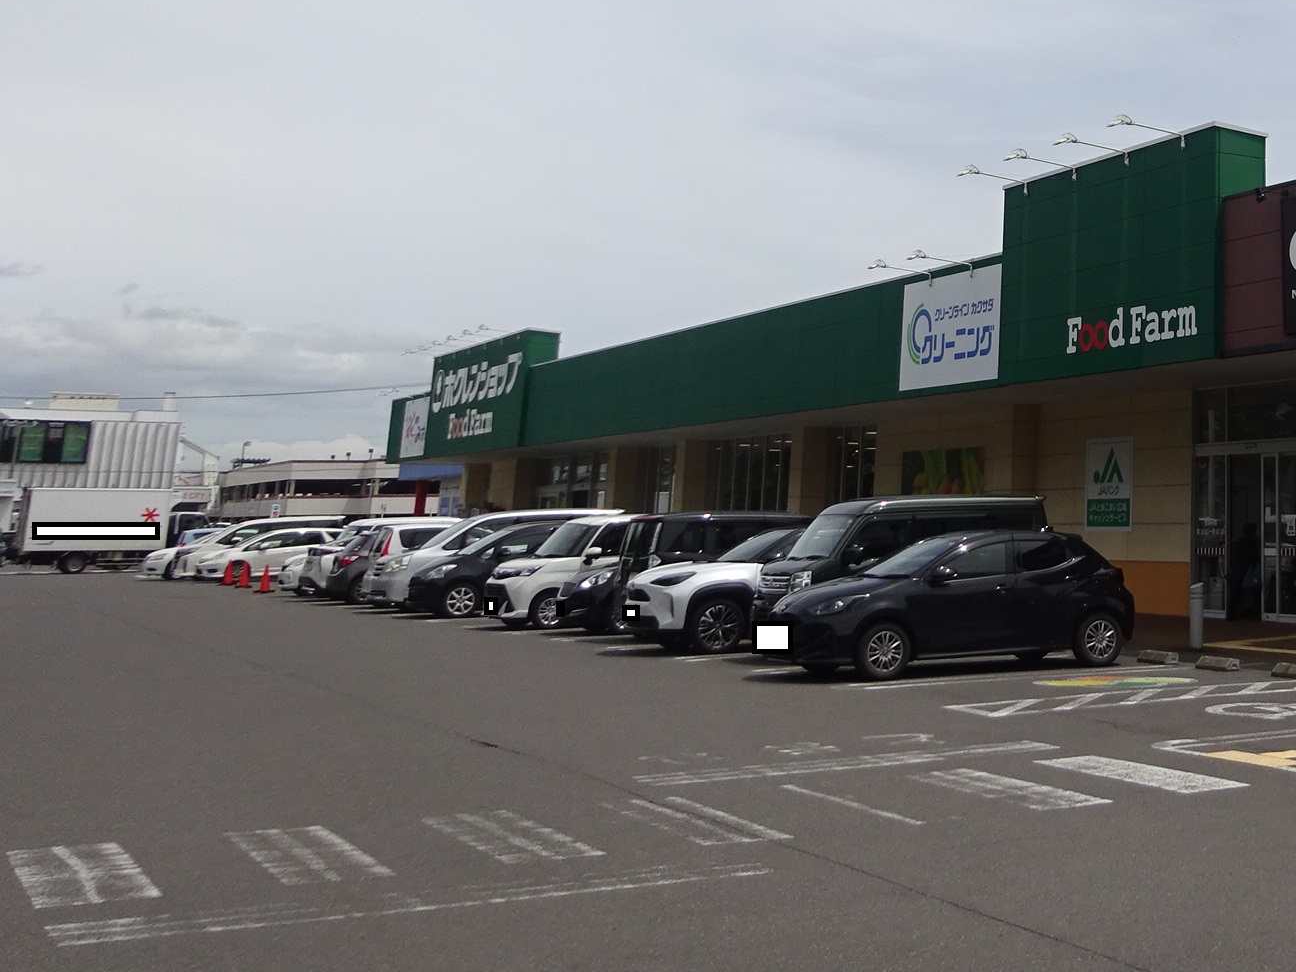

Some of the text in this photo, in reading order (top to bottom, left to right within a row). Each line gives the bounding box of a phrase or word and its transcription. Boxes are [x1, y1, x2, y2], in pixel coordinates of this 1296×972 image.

[920, 324, 996, 365] クリーニング
[1066, 305, 1198, 354] Food Farm
[441, 351, 524, 409] ホクレンショップ
[446, 408, 470, 440] Food
[469, 408, 494, 437] Farm
